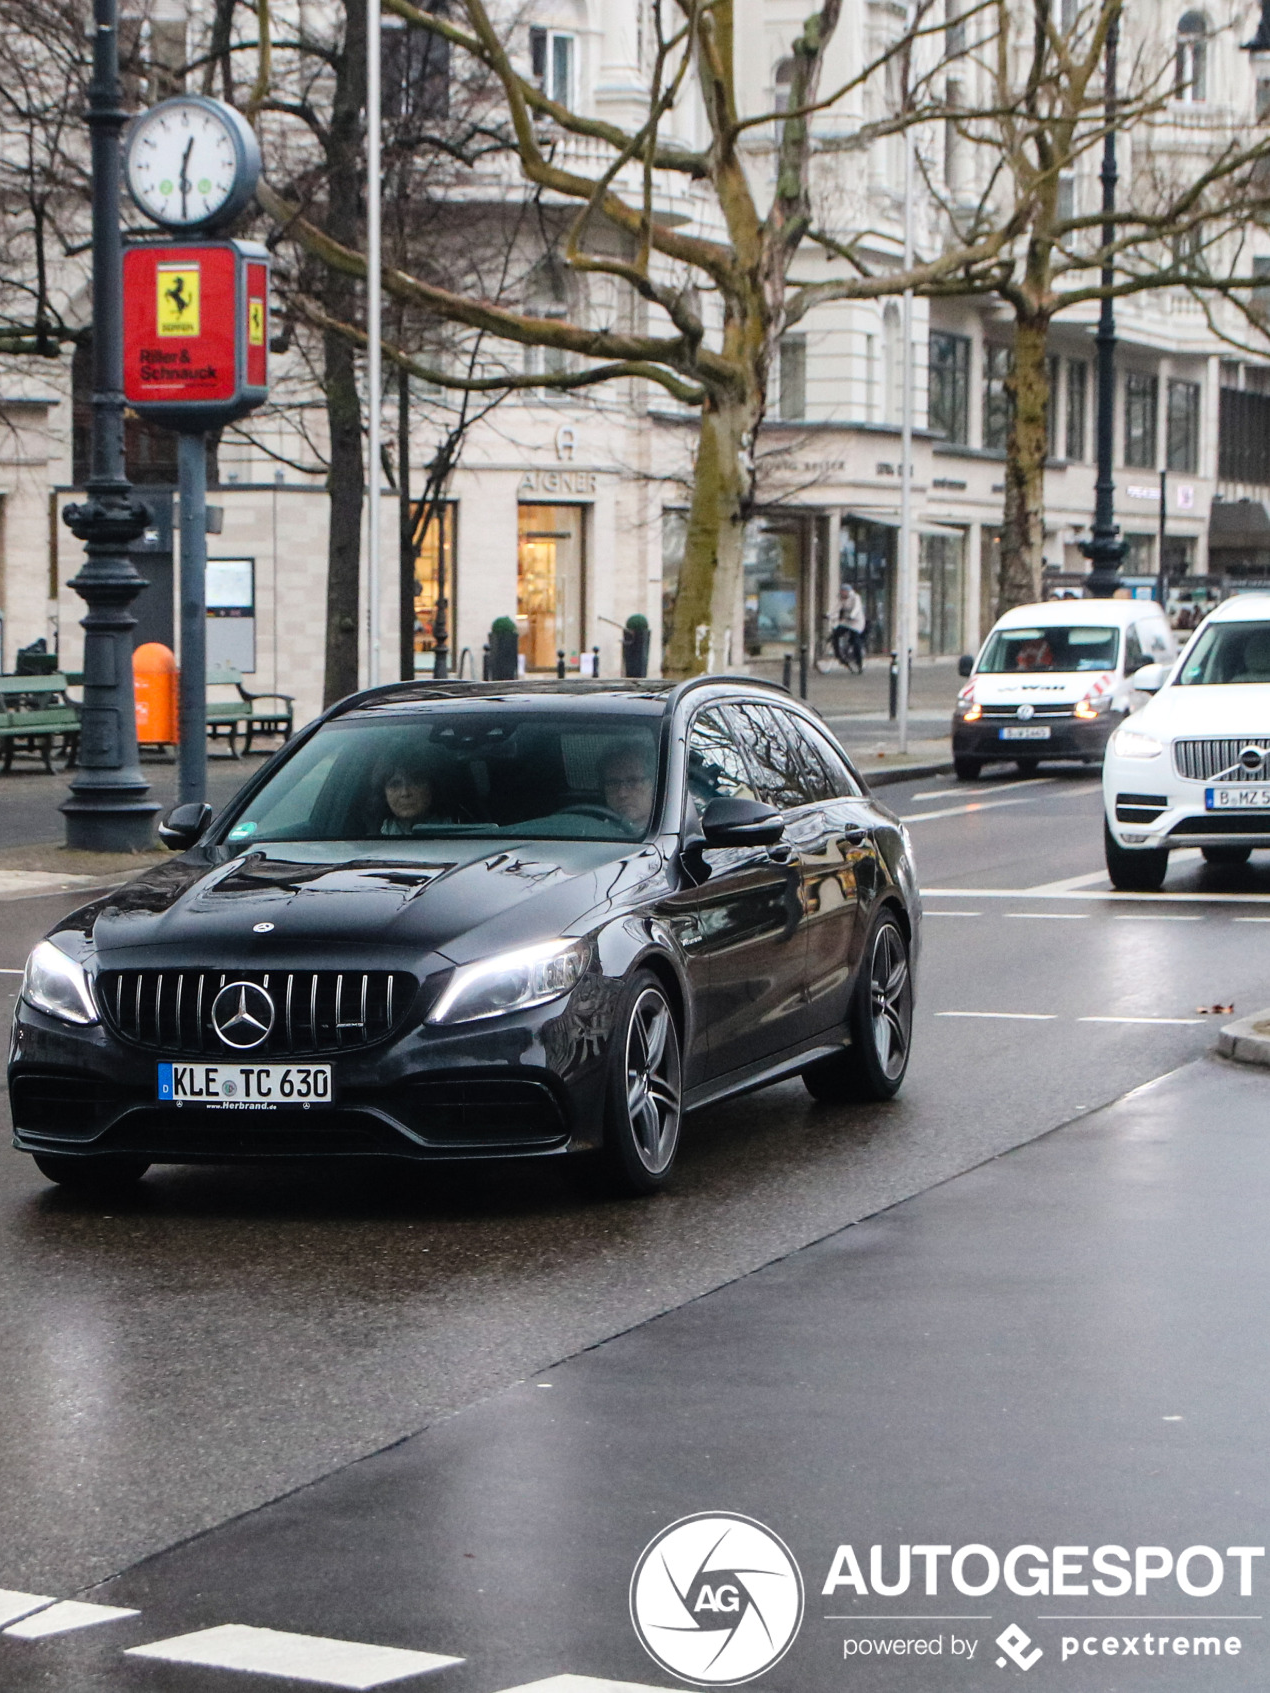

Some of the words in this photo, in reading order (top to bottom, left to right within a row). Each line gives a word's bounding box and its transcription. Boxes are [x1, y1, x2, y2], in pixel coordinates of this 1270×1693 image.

[140, 349, 177, 363] Riller
[180, 349, 191, 363] &
[140, 365, 217, 380] Schnauck
[521, 471, 596, 493] AIGNER
[1220, 791, 1229, 805] B
[1239, 791, 1258, 805] MZ
[162, 1084, 169, 1093] D
[174, 1068, 219, 1096] KLE
[240, 1069, 272, 1097] TC
[280, 1069, 328, 1097] 630
[206, 1101, 277, 1110] www.Herbrand.de
